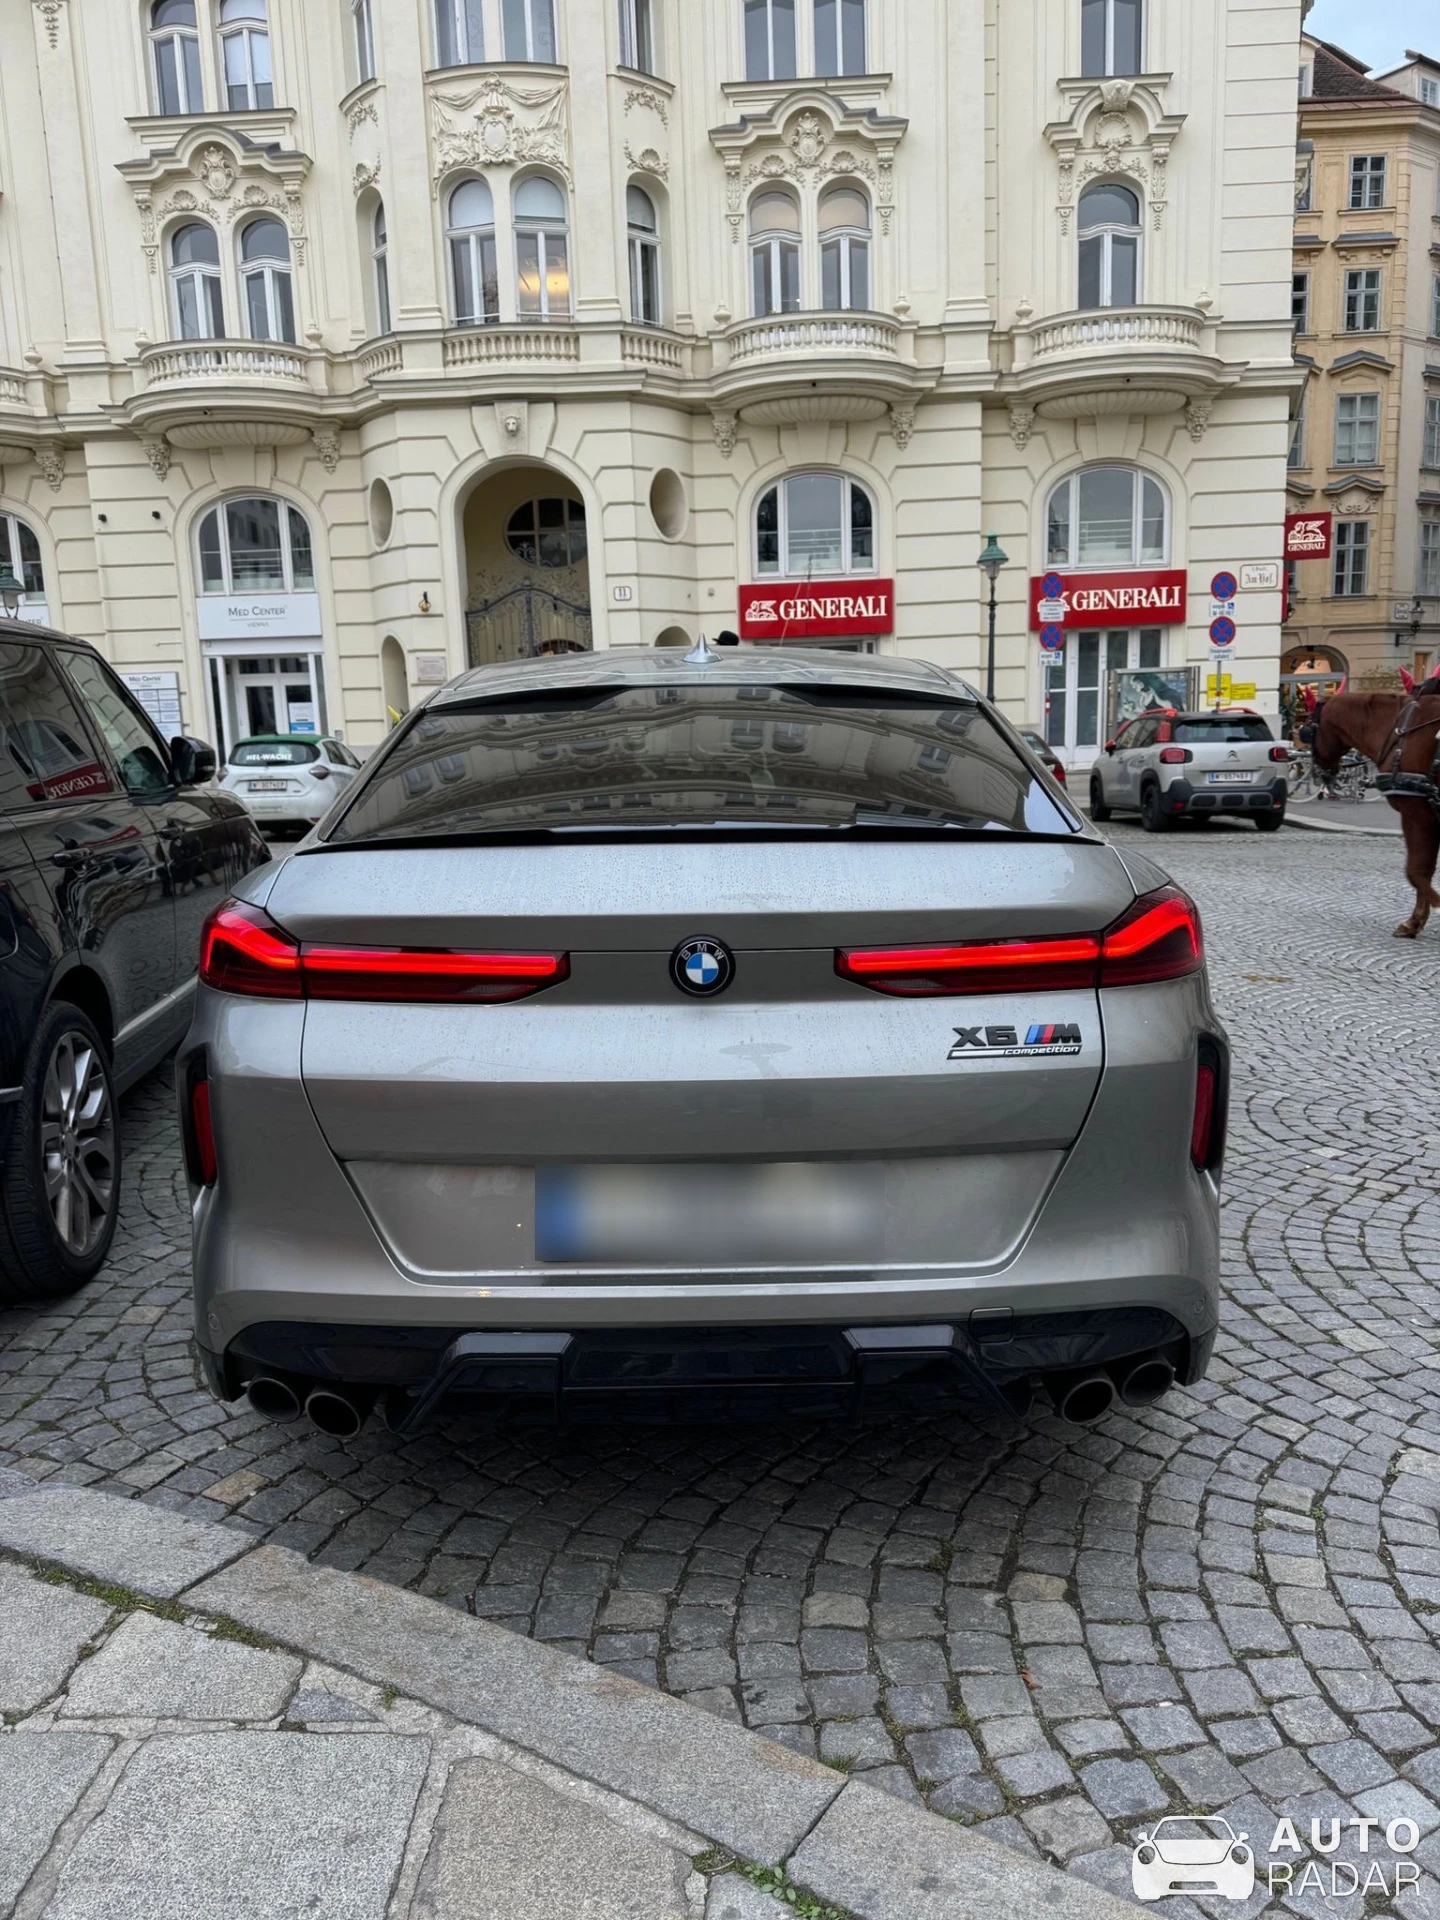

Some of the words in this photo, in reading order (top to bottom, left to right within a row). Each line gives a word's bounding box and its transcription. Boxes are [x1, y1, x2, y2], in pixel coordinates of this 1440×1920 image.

[1288, 542, 1326, 551] GENERALI
[779, 595, 887, 620] GENERALI
[1072, 586, 1181, 611] GENERALI
[680, 943, 725, 961] BMW
[951, 1025, 1018, 1047] X6
[1004, 1045, 1079, 1055] competition
